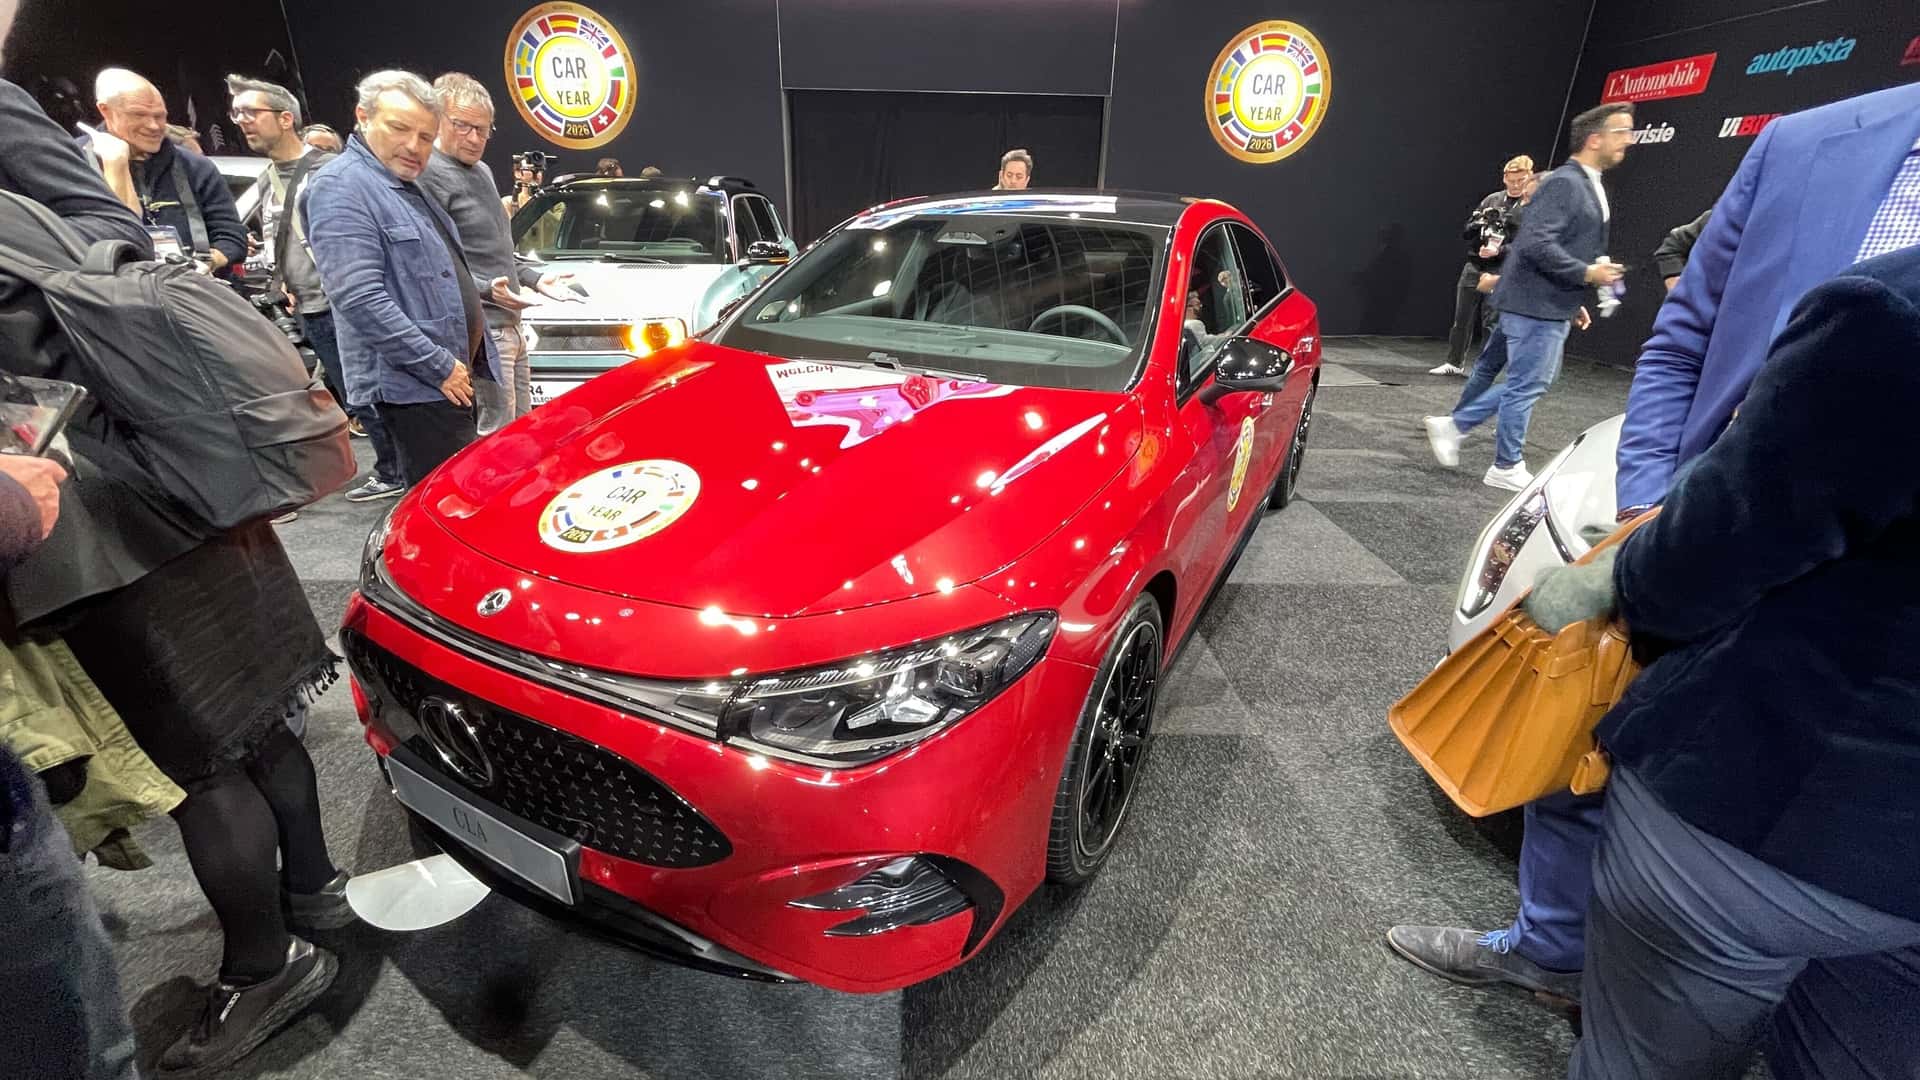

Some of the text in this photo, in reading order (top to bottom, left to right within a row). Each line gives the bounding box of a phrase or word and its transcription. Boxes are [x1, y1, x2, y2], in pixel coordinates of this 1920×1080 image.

[1745, 37, 1857, 76] autopista
[552, 56, 588, 79] CAR
[1252, 73, 1286, 96] CAR
[1607, 61, 1700, 97] L'Automobile
[556, 90, 592, 106] YEAR
[1250, 106, 1283, 121] YEAR
[565, 123, 590, 136] 2026
[1631, 121, 1675, 144] visie
[1249, 138, 1273, 151] 2026
[606, 486, 647, 504] CAR
[587, 505, 622, 520] YEAR
[453, 807, 488, 843] CLA
